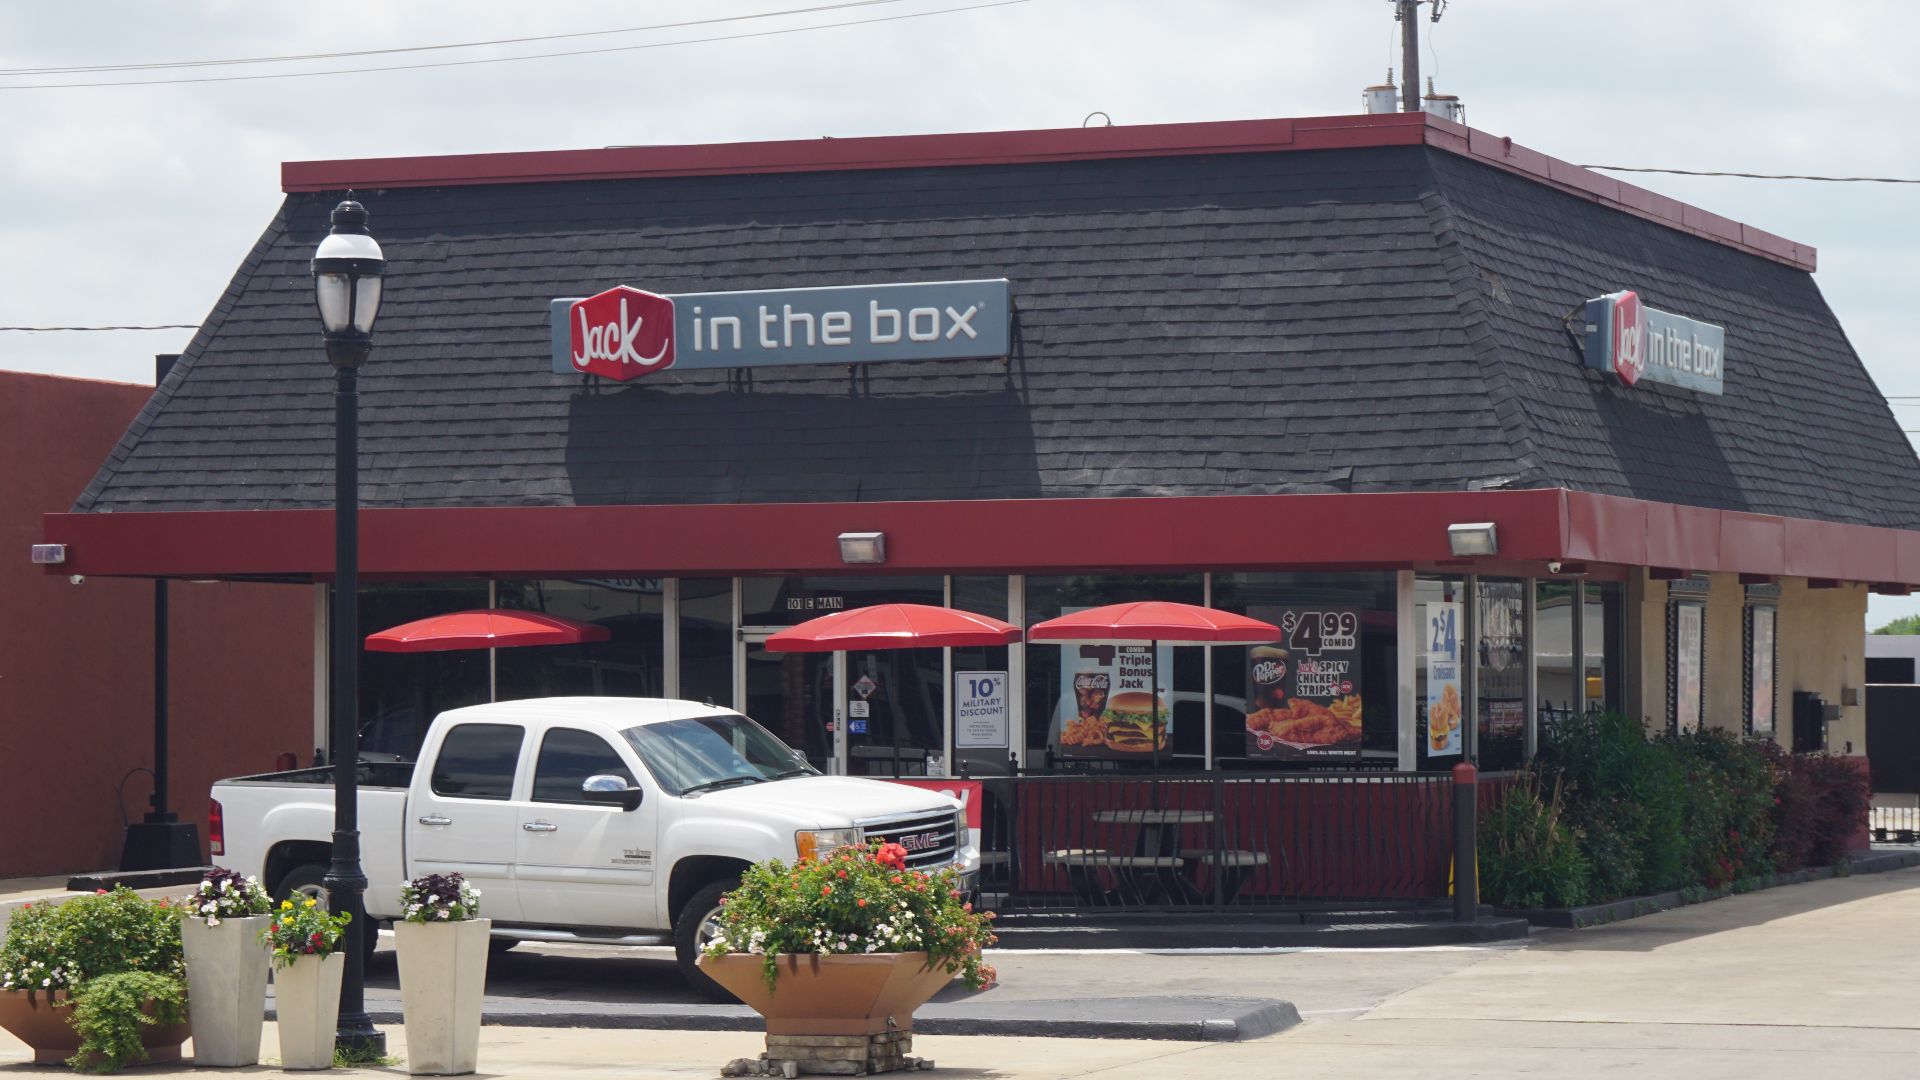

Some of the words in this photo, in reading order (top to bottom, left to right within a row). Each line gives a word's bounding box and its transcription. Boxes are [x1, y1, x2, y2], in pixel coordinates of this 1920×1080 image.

[574, 298, 669, 367] Jack
[694, 306, 742, 351] in
[759, 304, 852, 348] the
[1617, 303, 1646, 371] Jack
[1648, 320, 1665, 366] in
[1666, 326, 1692, 372] the
[1694, 332, 1720, 378] box
[806, 598, 813, 609] E
[816, 597, 842, 608] MAIN
[1323, 638, 1353, 647] COMBO
[1120, 655, 1152, 667] Triple
[1264, 661, 1277, 672] Dr
[1119, 667, 1153, 677] Bonus
[1320, 661, 1349, 673] SPICY
[1433, 664, 1456, 681] Croissants
[1253, 664, 1283, 683] Pepper
[1297, 674, 1339, 684] CHICKEN
[1120, 678, 1144, 689] Jack
[1297, 684, 1332, 695] STRIPS
[963, 698, 1001, 709] MILITARY
[960, 706, 1004, 717] DISCOUNT
[900, 831, 940, 851] GMC
